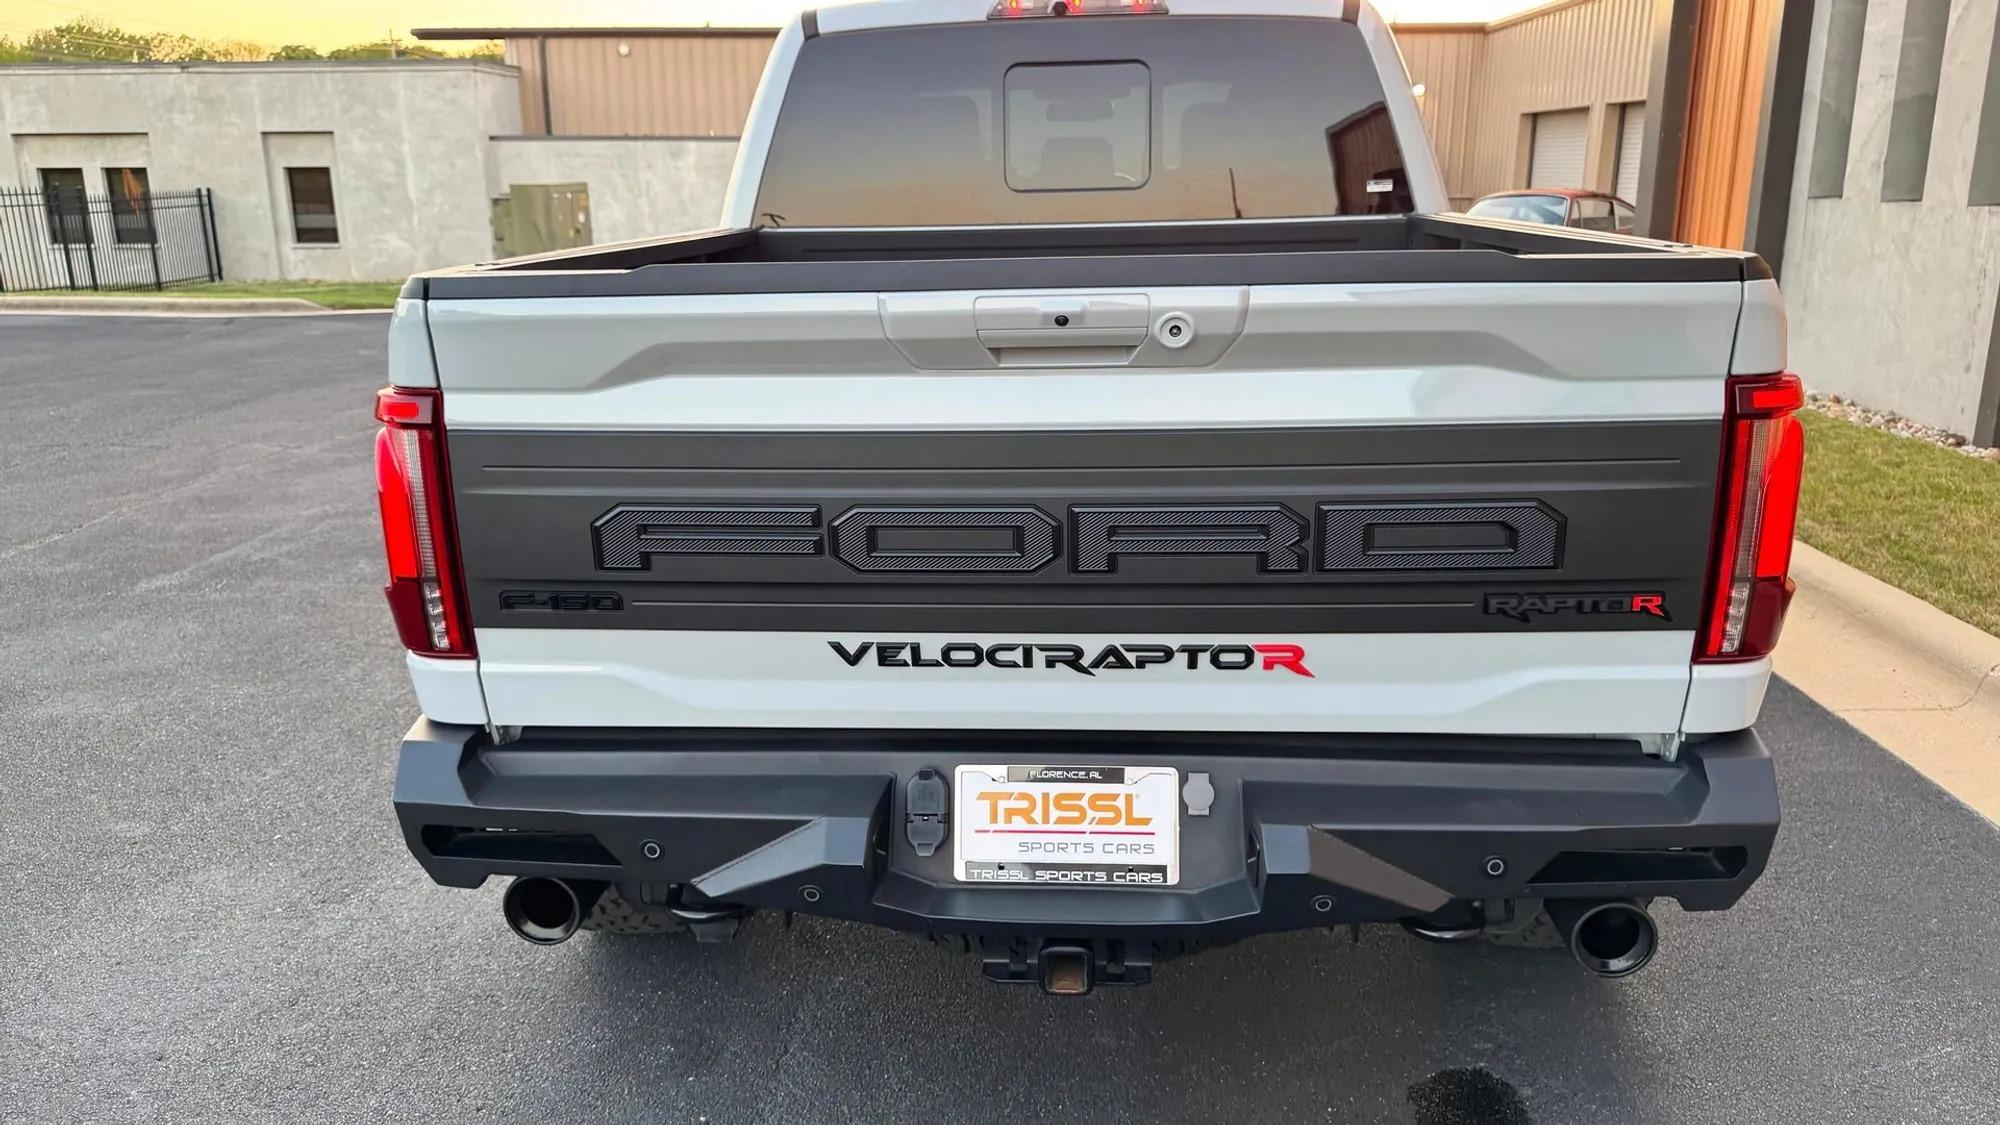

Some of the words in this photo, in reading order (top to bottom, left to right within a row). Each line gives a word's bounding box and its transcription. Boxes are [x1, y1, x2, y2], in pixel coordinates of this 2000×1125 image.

[592, 499, 1567, 574] FORD
[500, 590, 624, 611] F-150
[1483, 592, 1672, 622] RAPTOR
[827, 640, 1315, 678] VELOCIRAPTOR
[1091, 771, 1103, 780] AL
[1018, 841, 1094, 854] SPORTS
[1102, 843, 1155, 855] CARS
[970, 869, 1028, 880] TRISSL
[1035, 870, 1107, 882] SPORTS
[1113, 872, 1163, 883] CARS
